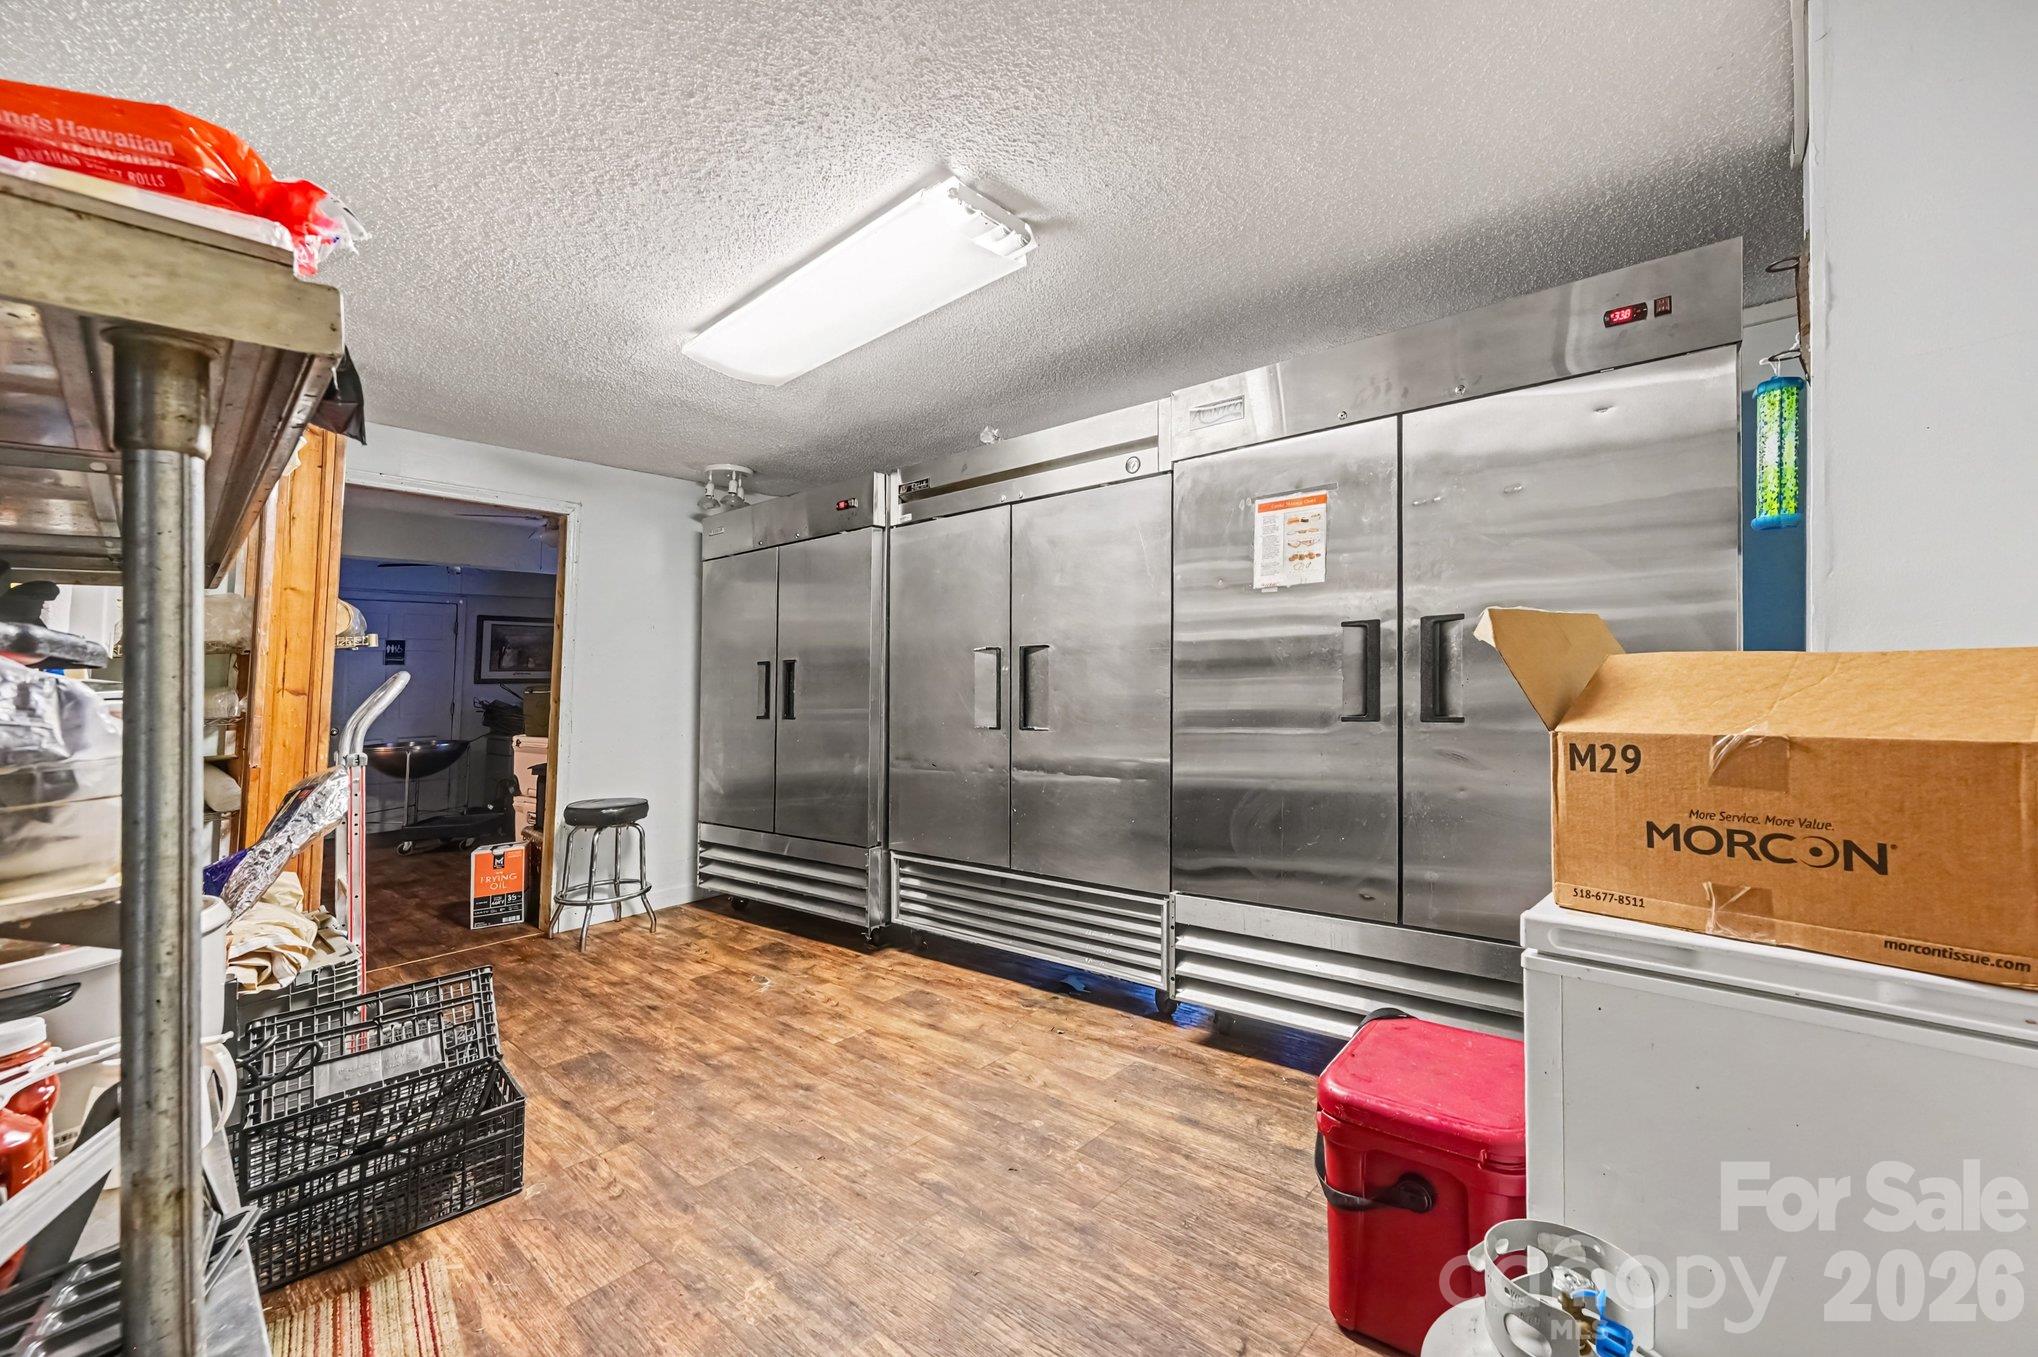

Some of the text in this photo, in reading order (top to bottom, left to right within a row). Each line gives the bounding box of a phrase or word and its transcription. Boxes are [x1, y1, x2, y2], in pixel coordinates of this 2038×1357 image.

[55, 118, 176, 157] Hawaiian
[127, 170, 166, 188] ROLLS
[1568, 742, 1642, 775] M29
[1688, 809, 1835, 831] More Service. More Value.
[1645, 820, 1889, 876] MORCON
[489, 881, 507, 890] OIL
[1572, 888, 1646, 908] 518-677-8511
[1883, 939, 2032, 973] morcontissue.com
